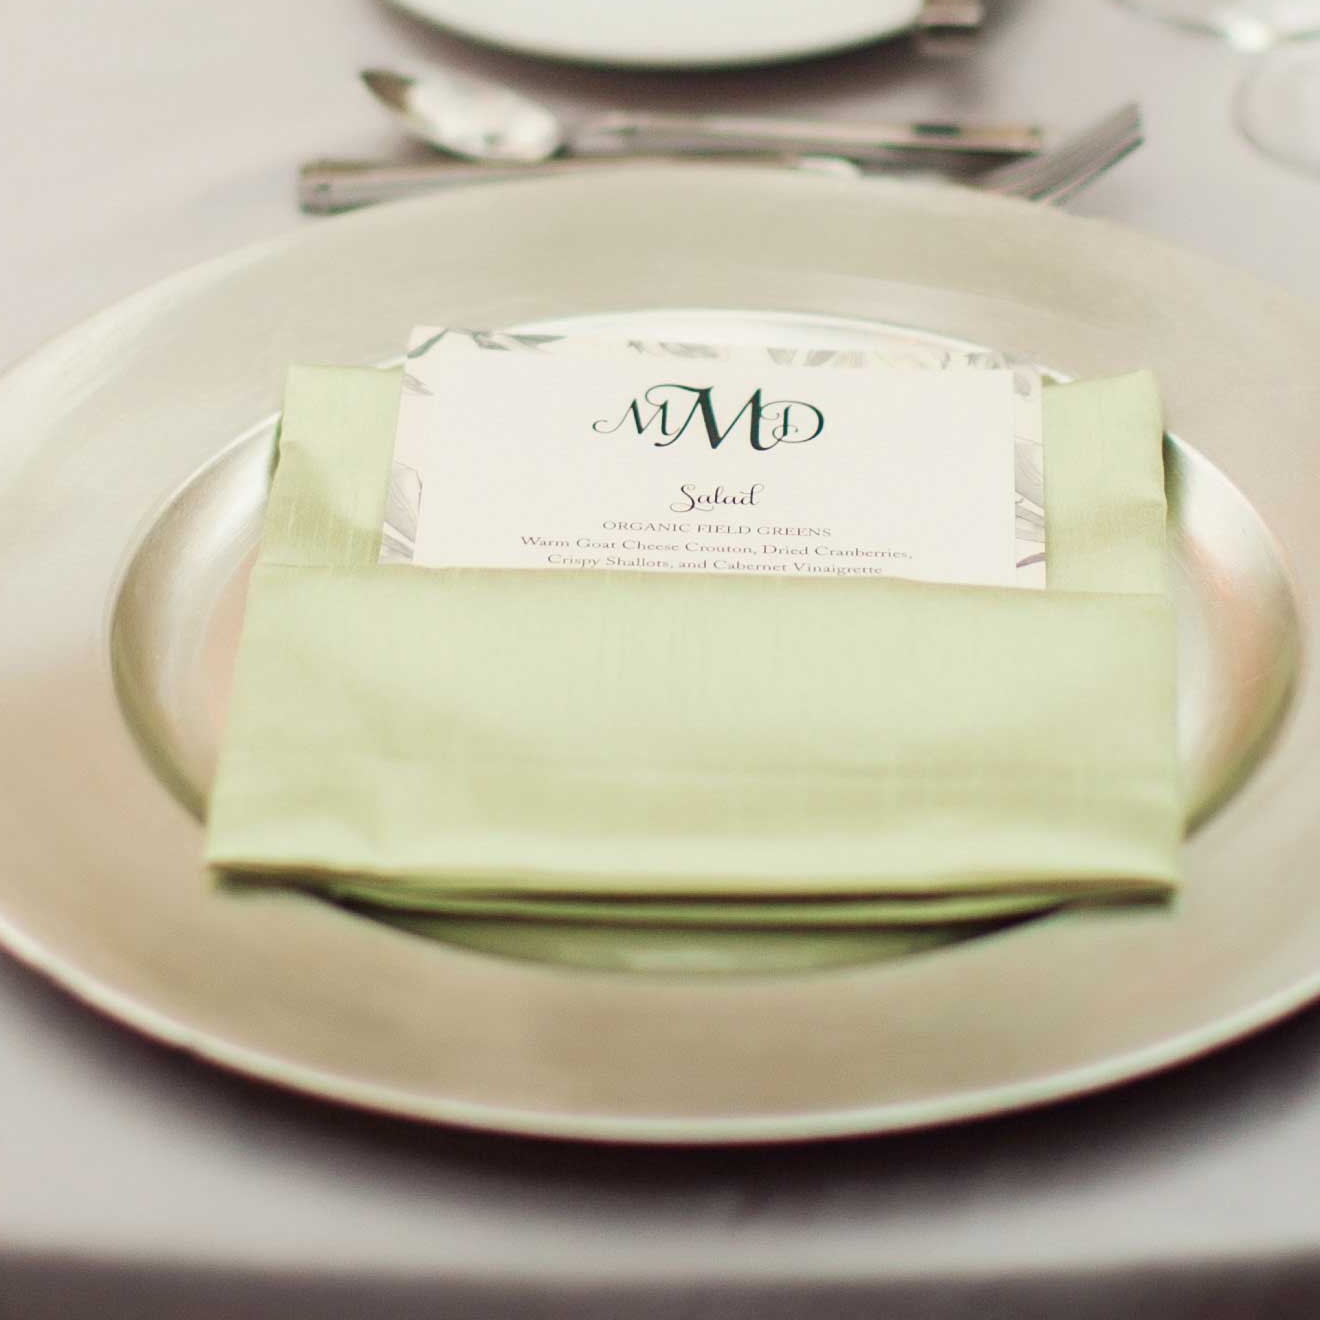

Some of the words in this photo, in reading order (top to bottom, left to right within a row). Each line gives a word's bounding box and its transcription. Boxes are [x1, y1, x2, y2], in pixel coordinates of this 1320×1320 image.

[669, 483, 764, 513] Salad
[602, 520, 691, 533] ORGANIC
[697, 523, 751, 535] FIELD
[757, 526, 831, 537] GREENS
[520, 535, 570, 547] Warm
[576, 537, 616, 549] Goat
[622, 538, 679, 551] Cheese
[685, 540, 757, 554] Crouton,
[762, 544, 808, 556] Dried
[814, 544, 913, 560] Cranberries,
[547, 553, 600, 568] Crispy
[606, 556, 673, 569] Shallots,
[678, 559, 707, 569] and
[713, 559, 787, 572] Cabernet
[793, 562, 883, 576] Vinaigrette
